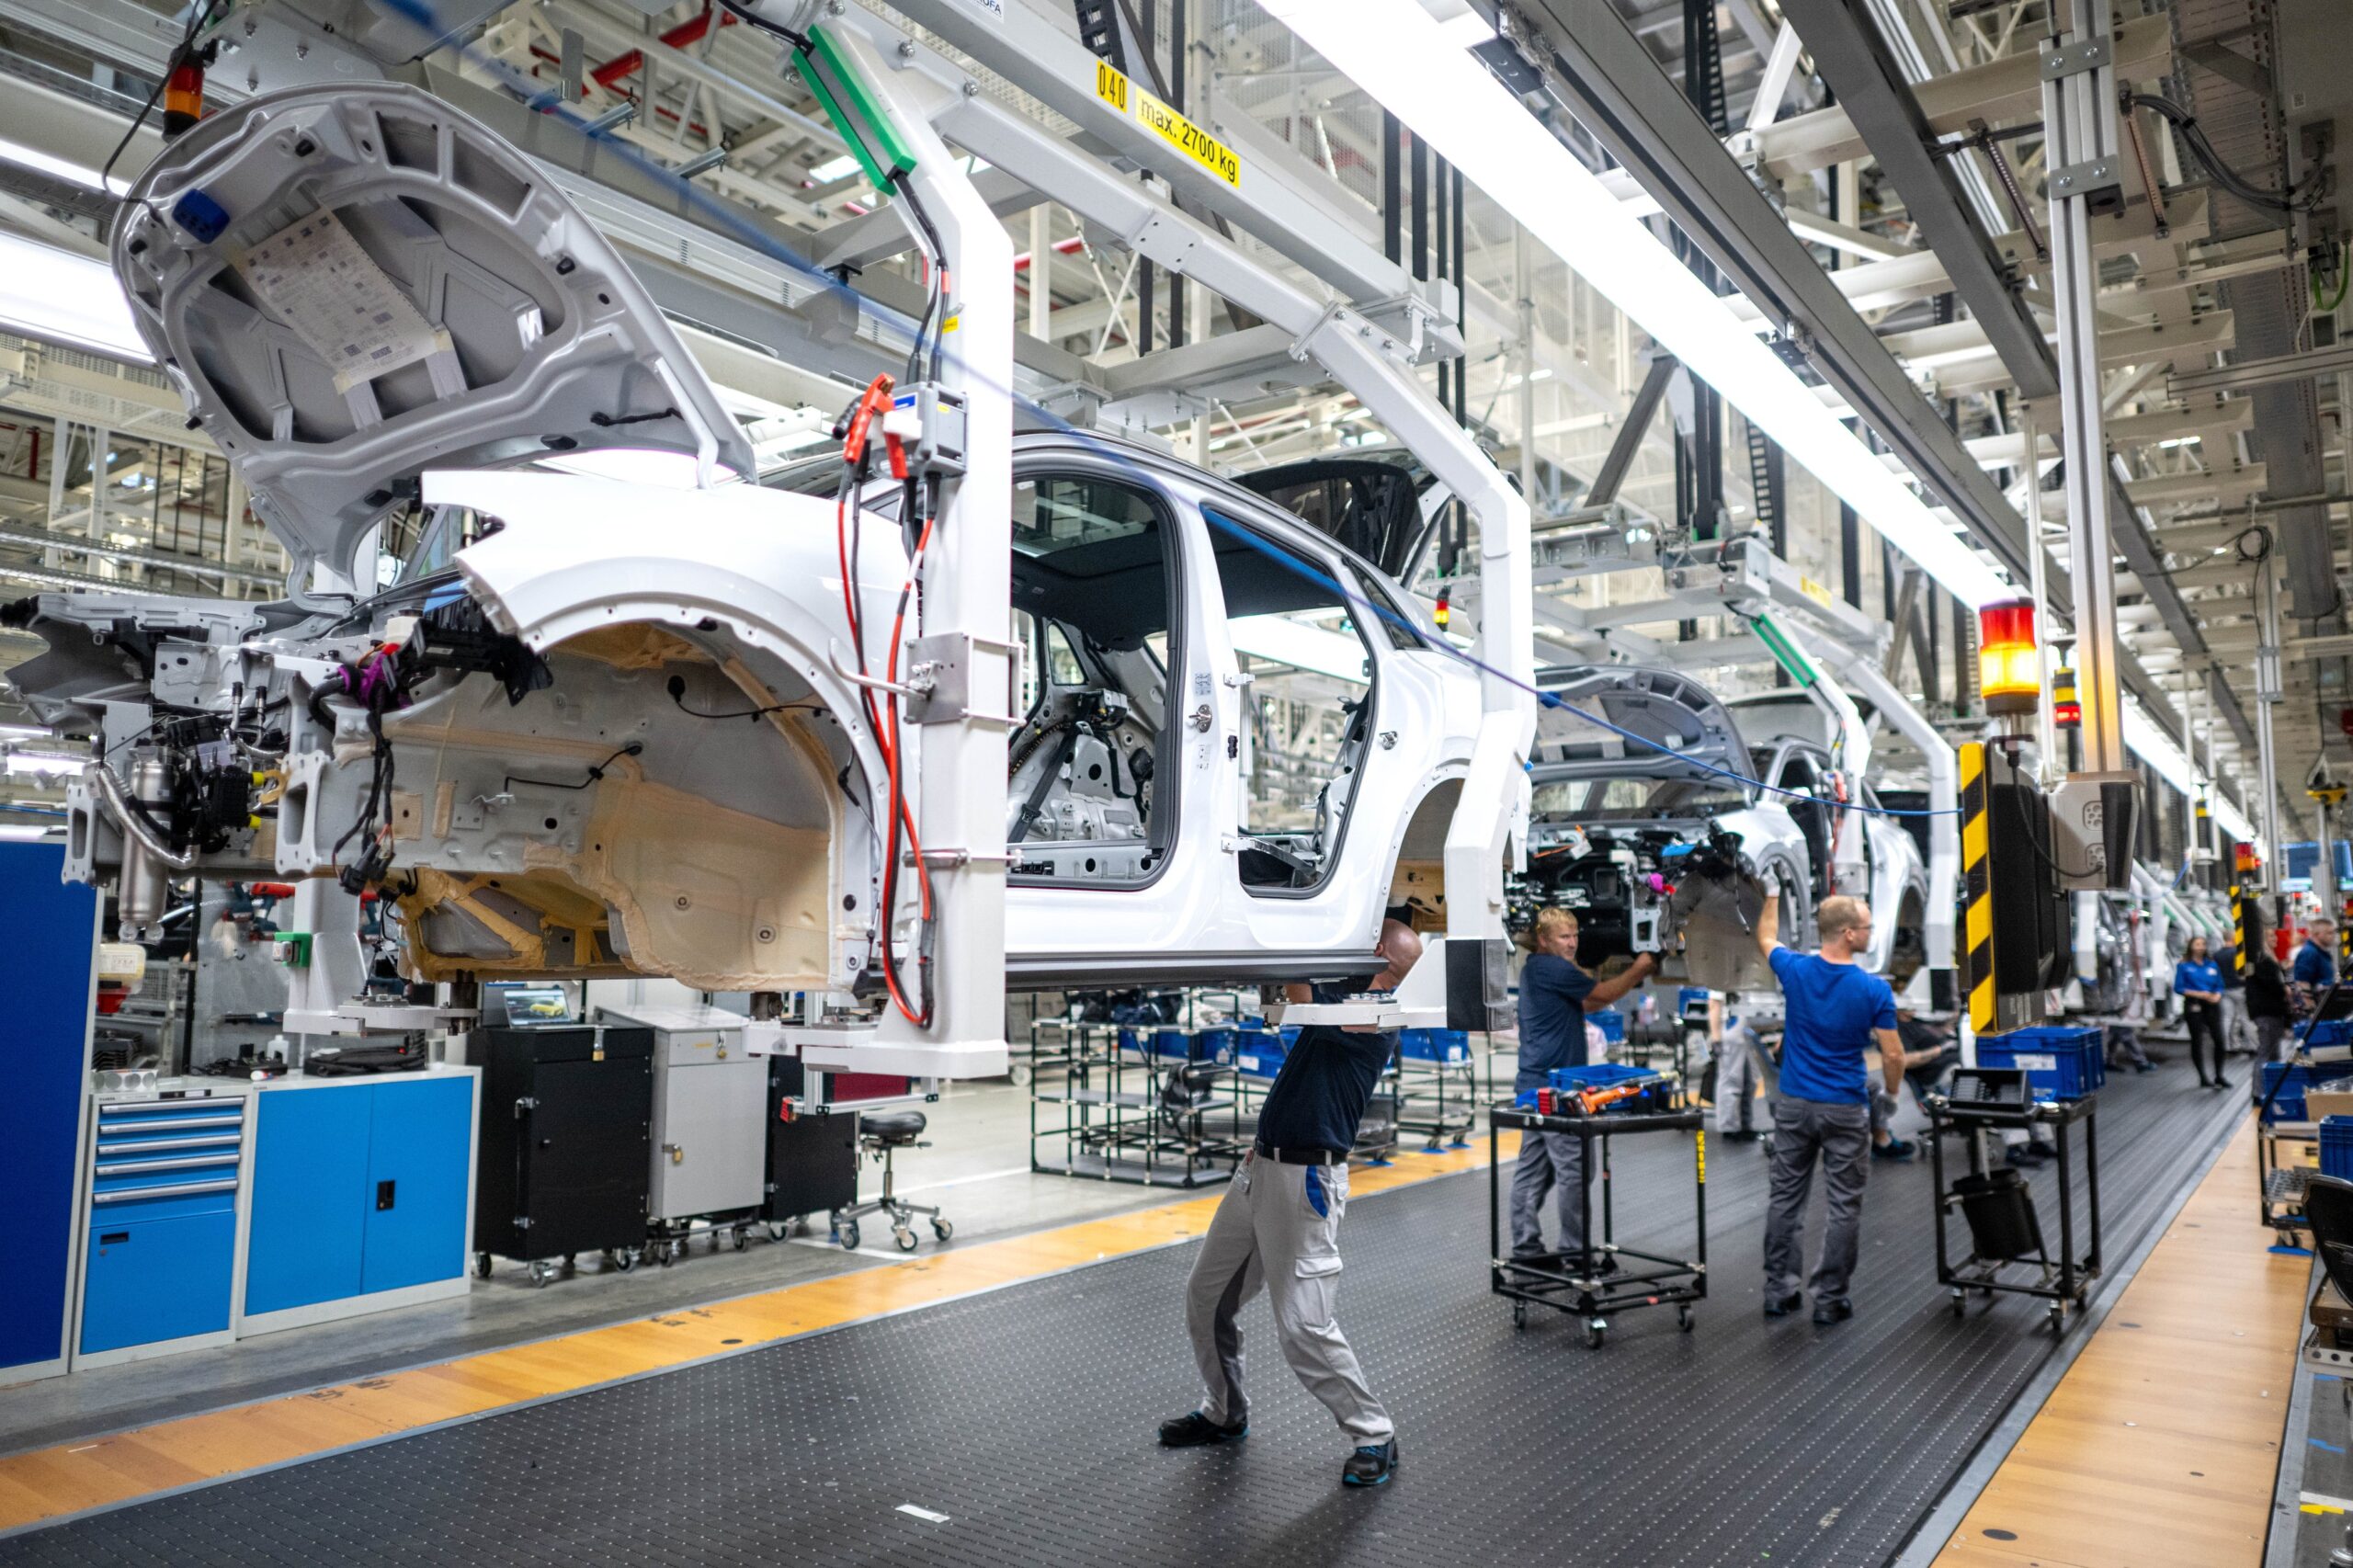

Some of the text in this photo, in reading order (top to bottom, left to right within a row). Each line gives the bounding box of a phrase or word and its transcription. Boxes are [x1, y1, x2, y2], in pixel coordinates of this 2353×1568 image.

[1099, 64, 1126, 109] 040
[1141, 98, 1236, 183] max. 2700 kg
